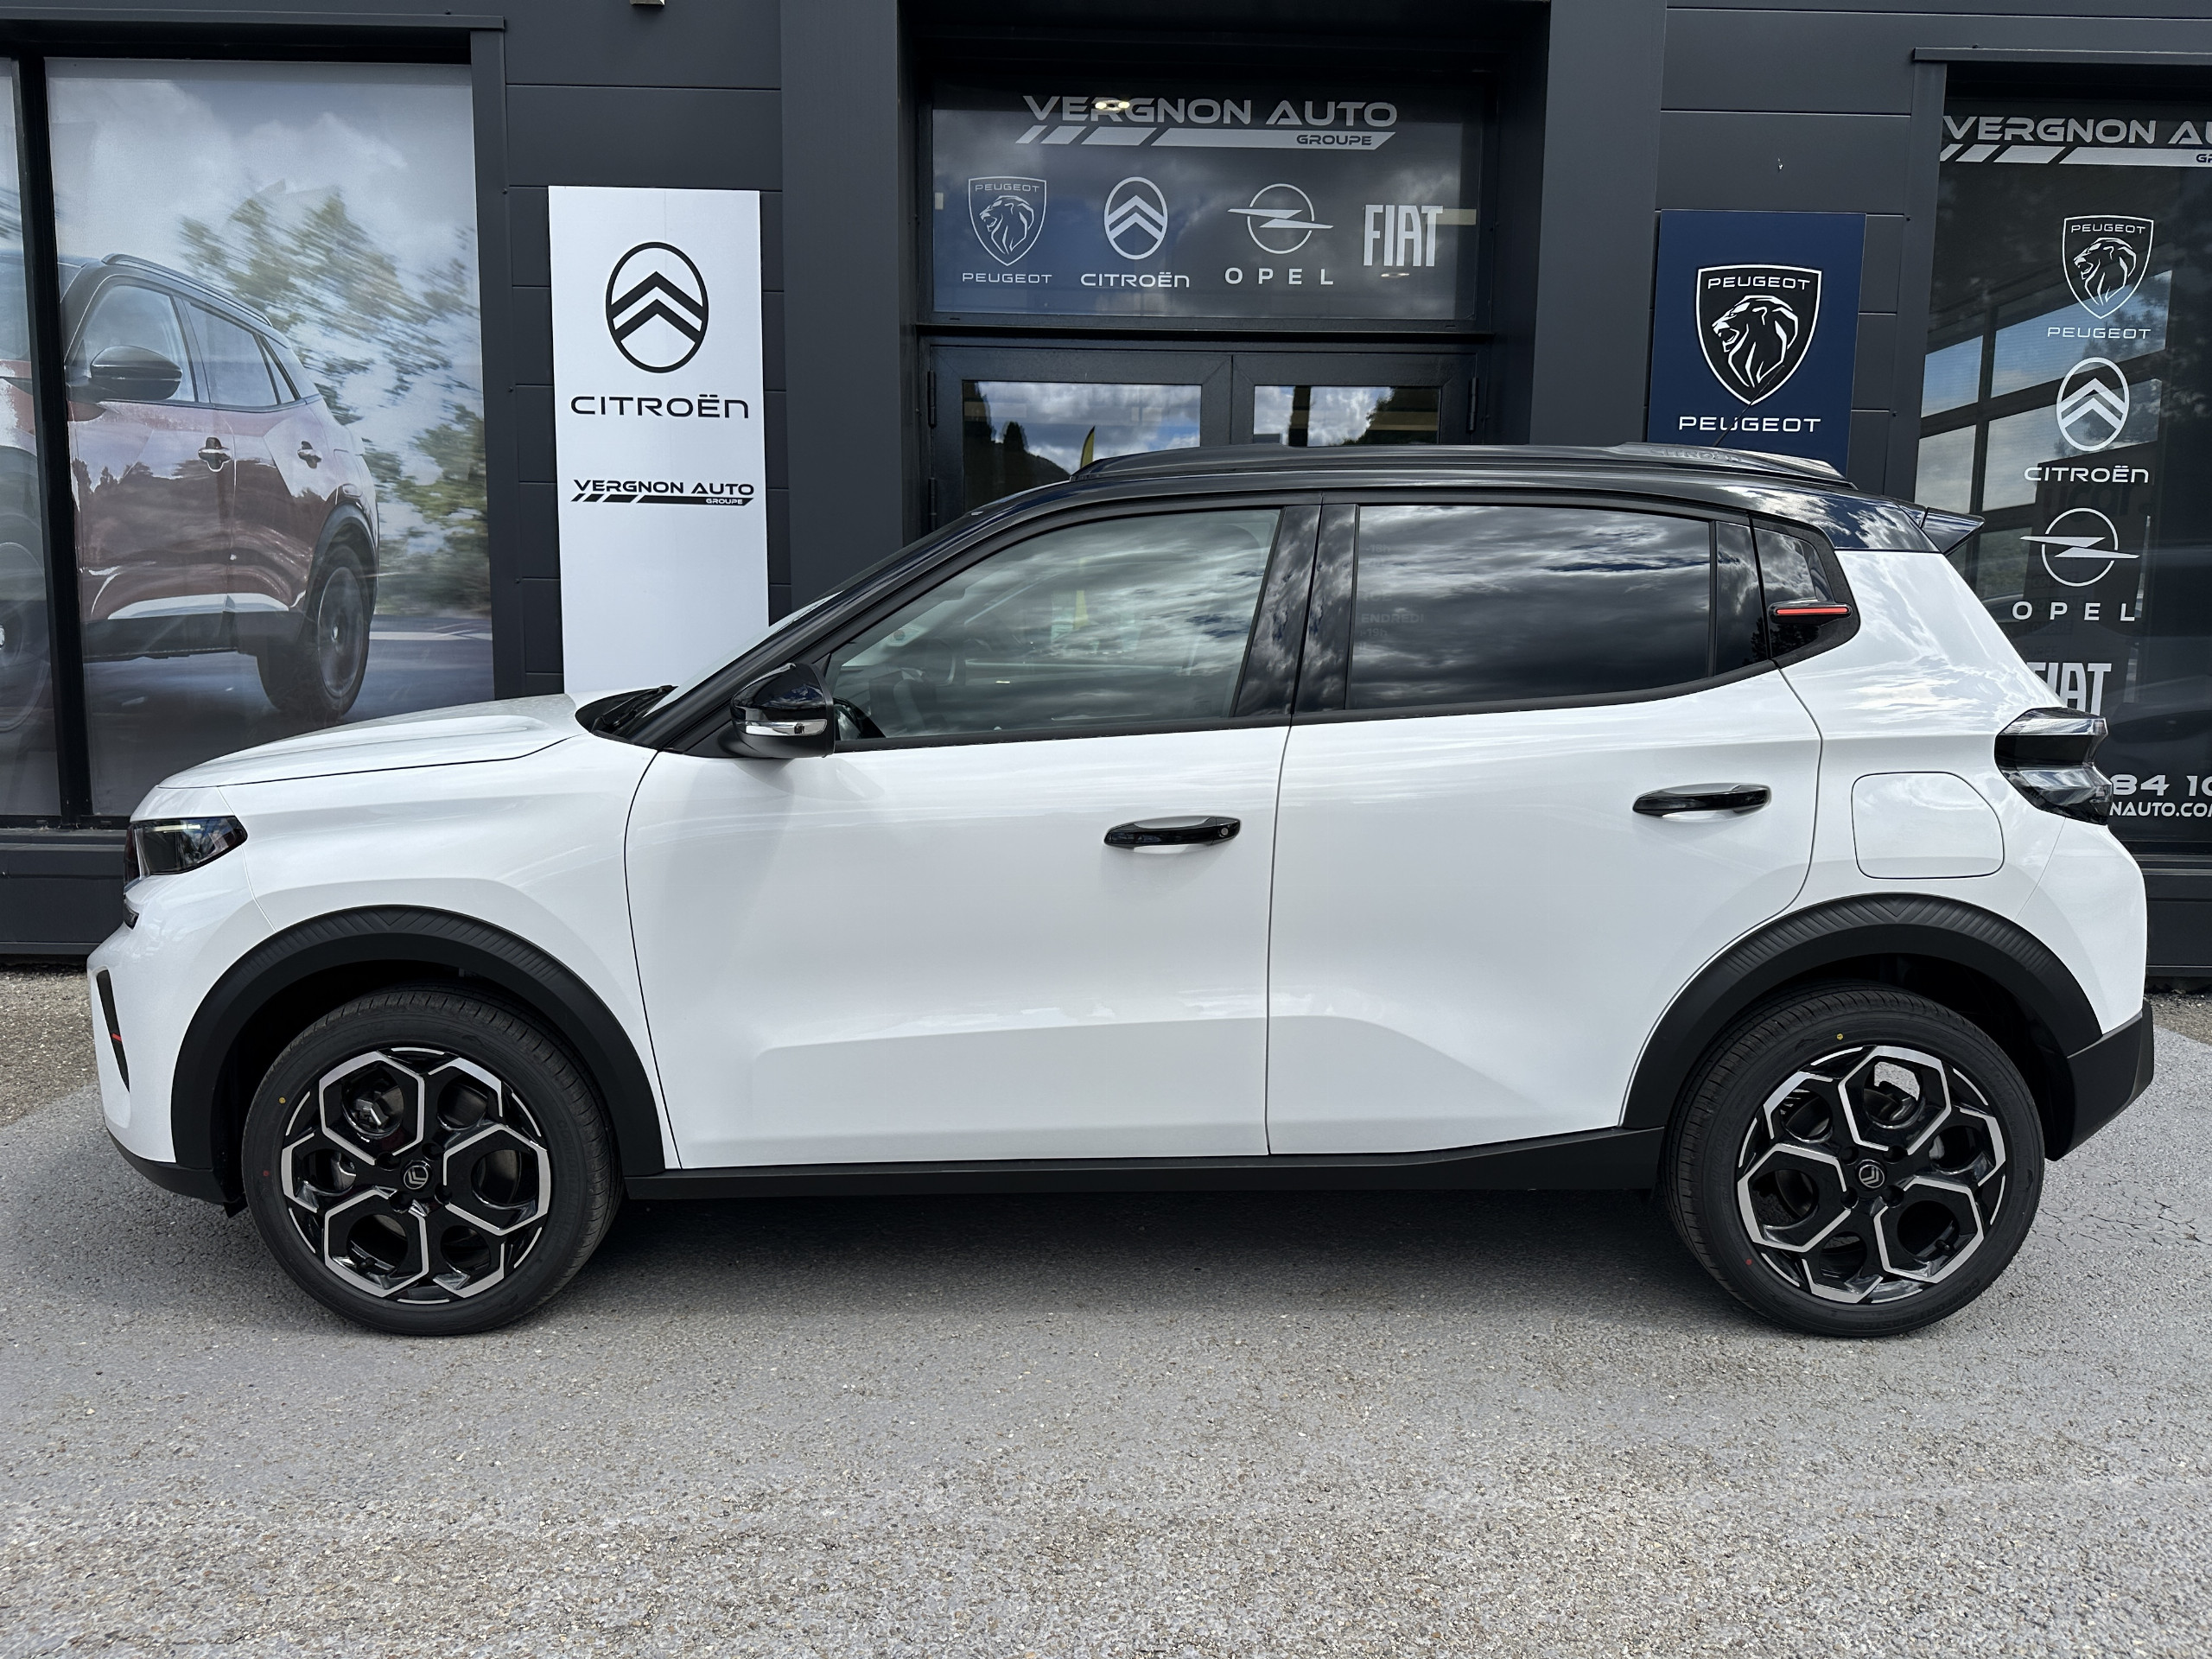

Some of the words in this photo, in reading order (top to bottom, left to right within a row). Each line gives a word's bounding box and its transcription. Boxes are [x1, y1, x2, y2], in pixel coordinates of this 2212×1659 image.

[1023, 95, 1251, 124] VERGNON
[1266, 99, 1398, 127] AUTO
[1943, 115, 2157, 144] VERGNON
[1296, 134, 1373, 146] GROUPE
[975, 183, 1040, 193] PEUGEOT
[1363, 204, 1444, 267] FIAT
[2070, 223, 2145, 234] PEUGEOT
[962, 272, 1052, 284] PEUGEOT
[1080, 271, 1190, 288] CITROËN
[1224, 267, 1334, 285] OPEL
[1707, 276, 1810, 290] PEUGEOT
[2047, 327, 2152, 340] PEUGEOT
[570, 393, 749, 419] CITROËN
[1679, 416, 1821, 433] PEUGEOT
[2024, 464, 2150, 484] CITROËN
[573, 478, 684, 494] VERGNON
[690, 481, 755, 496] AUTO
[705, 497, 743, 505] GROUPE
[2012, 601, 2136, 621] OPEL
